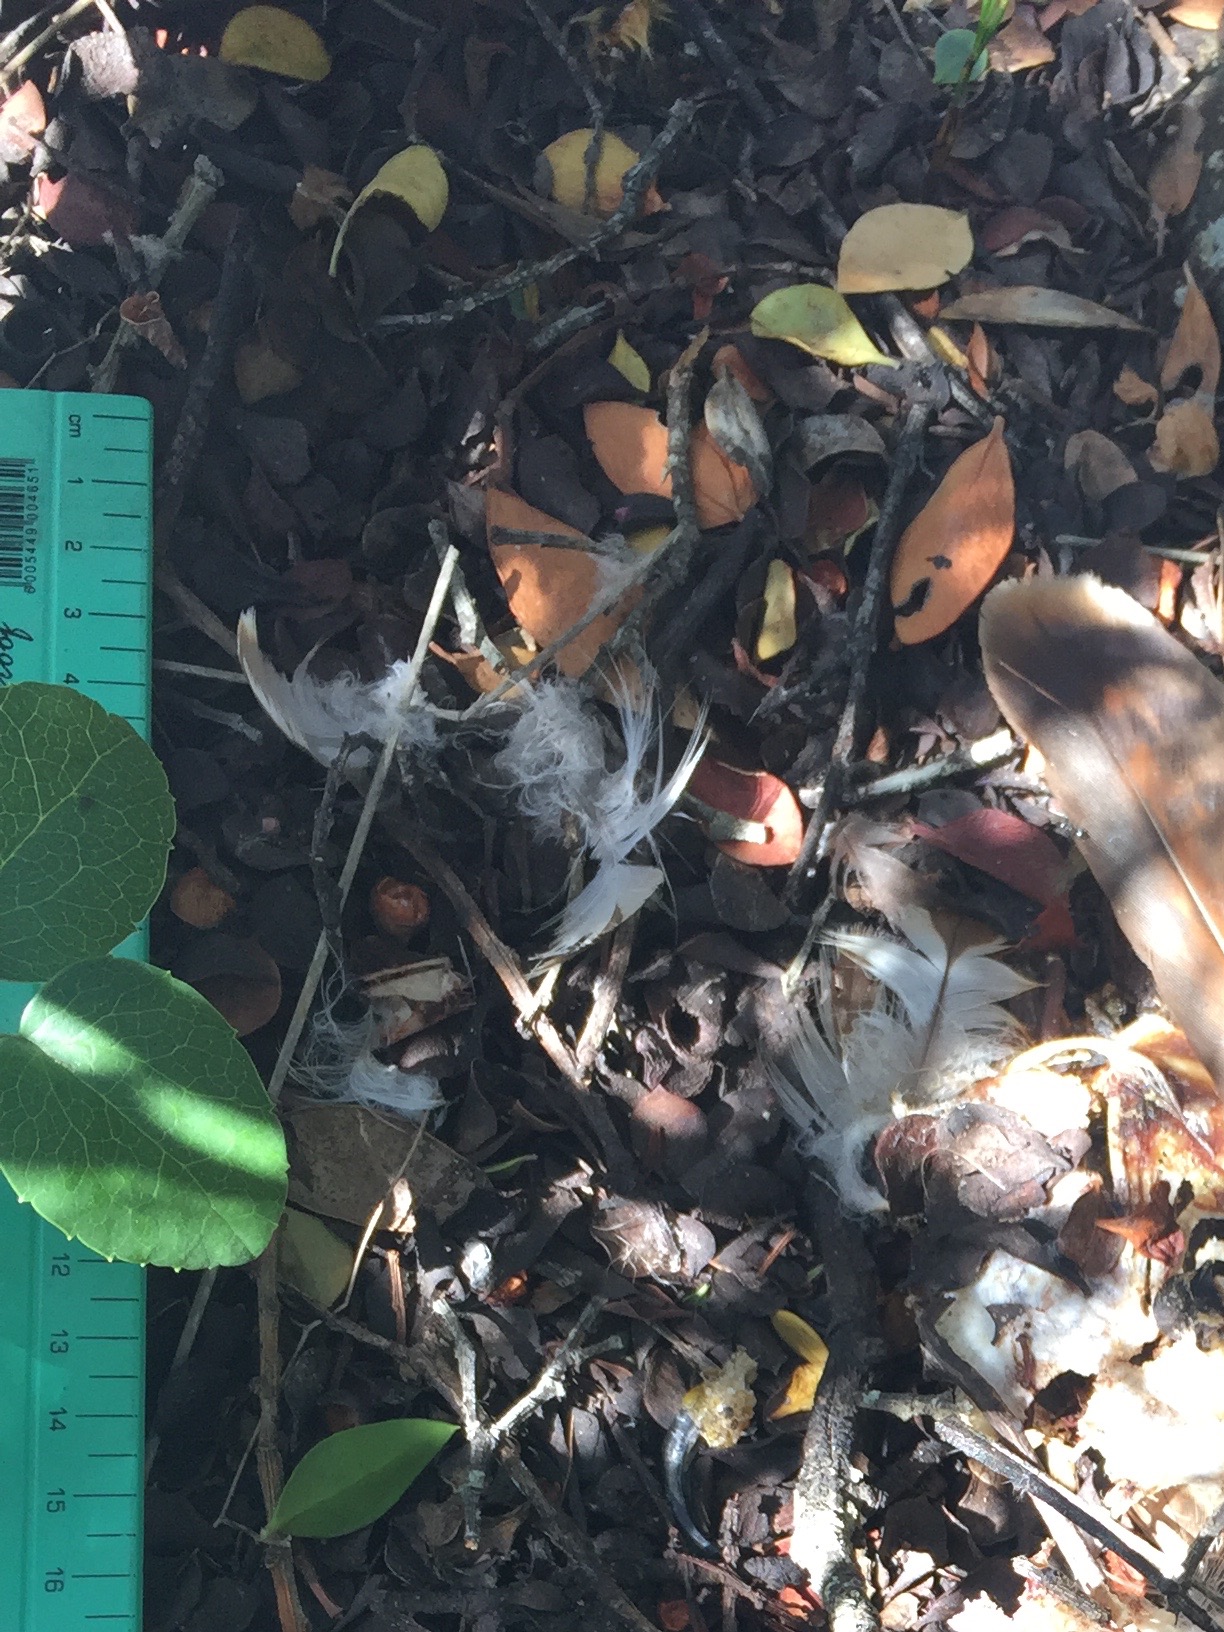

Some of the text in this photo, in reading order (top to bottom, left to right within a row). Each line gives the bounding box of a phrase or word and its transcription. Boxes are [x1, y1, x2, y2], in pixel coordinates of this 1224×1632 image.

[68, 415, 81, 438] cm
[65, 540, 82, 552] 2
[63, 608, 81, 618] 3
[63, 673, 79, 684] 4
[51, 1253, 70, 1277] 12
[49, 1330, 68, 1353] 13
[48, 1407, 67, 1431] 14
[46, 1488, 65, 1512] 15
[45, 1567, 64, 1592] 16
